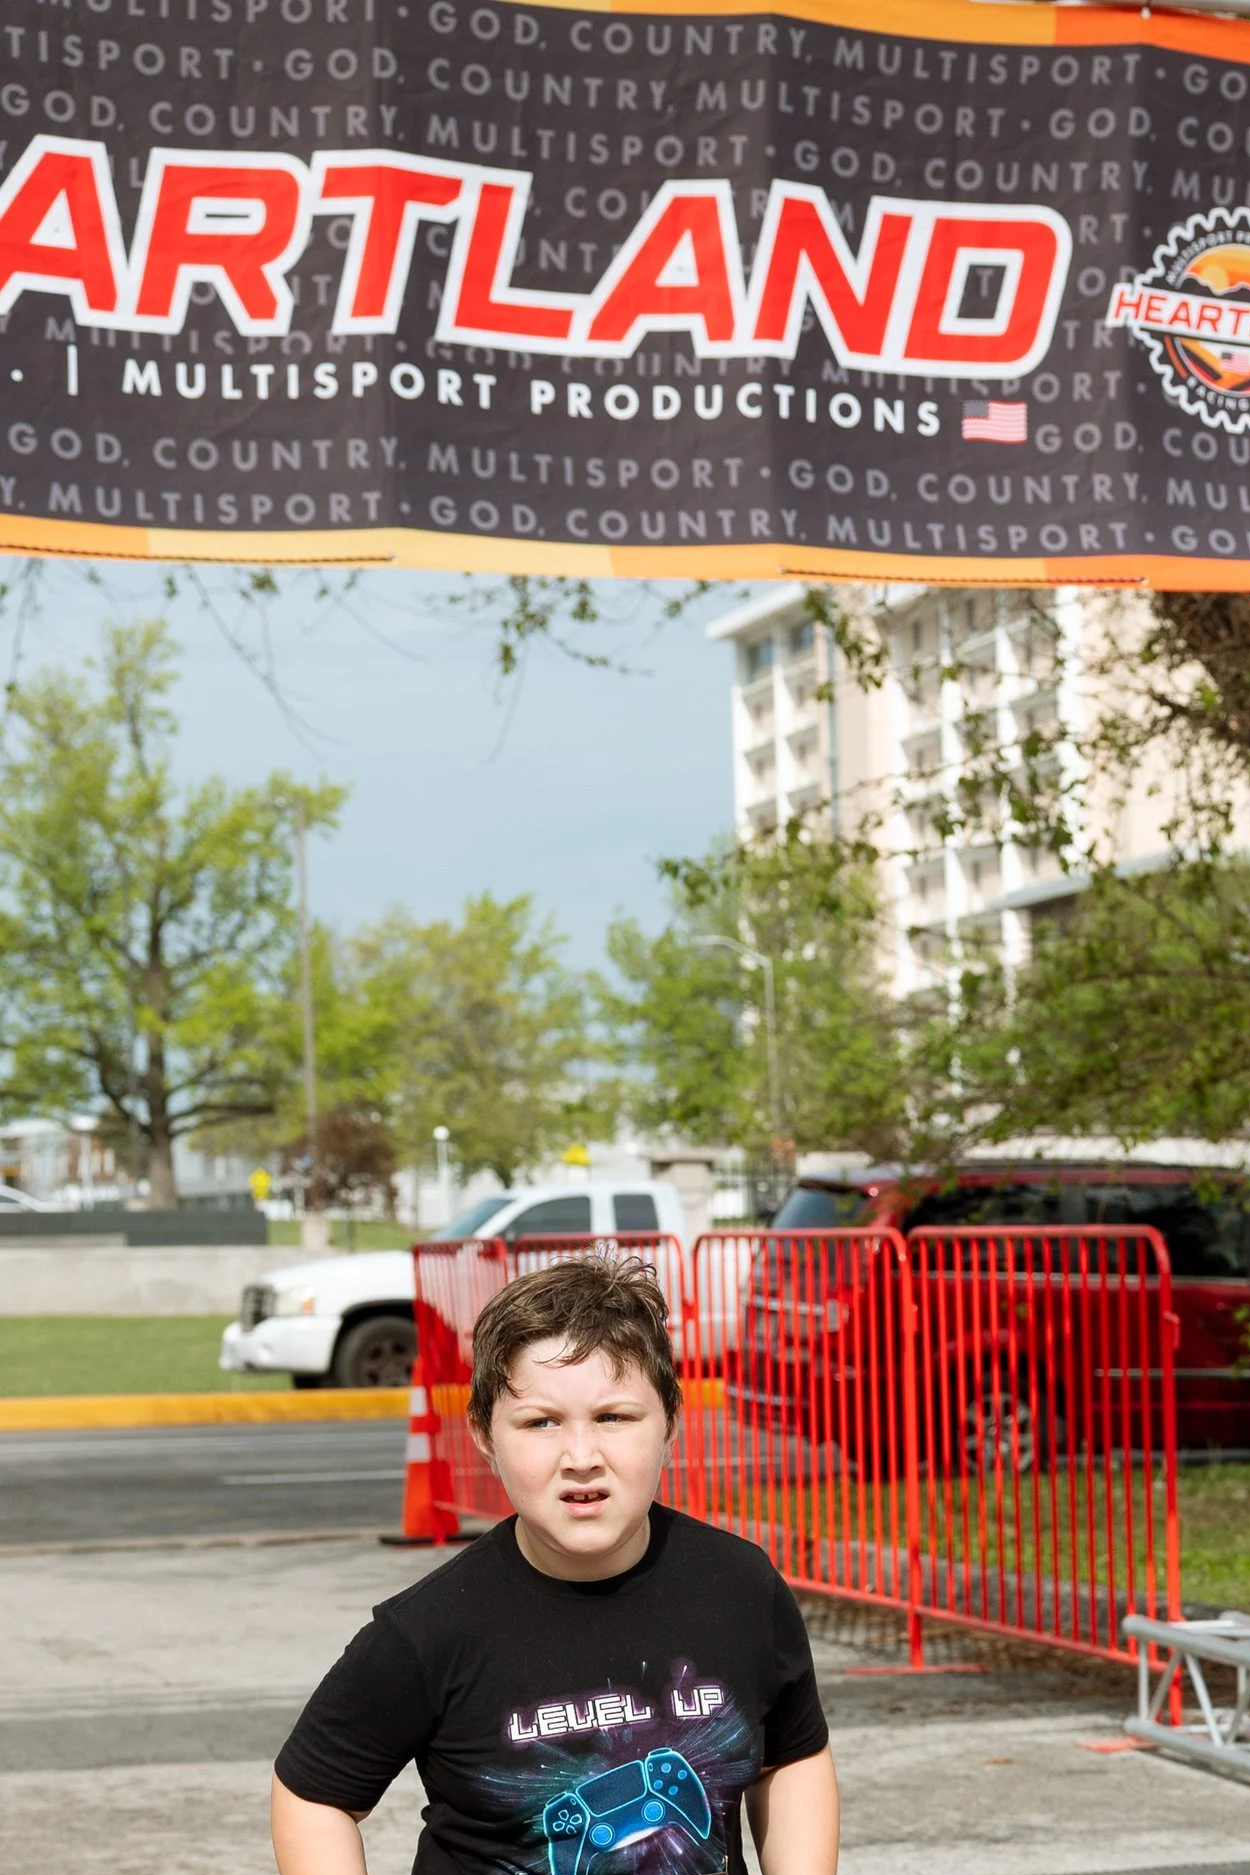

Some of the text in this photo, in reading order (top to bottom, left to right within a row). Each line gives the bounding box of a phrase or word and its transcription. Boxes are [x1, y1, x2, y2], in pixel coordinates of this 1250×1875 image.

[833, 37, 1141, 86] MULTISPORT
[696, 80, 1005, 138] MULTISPORT
[427, 114, 748, 168] MULTISPORT
[0, 134, 1073, 381] ARTLAND
[122, 357, 940, 436] MULTISPORT PRODUCTIONS
[1186, 375, 1250, 411] RACING
[427, 442, 744, 489] MULTISPORT
[49, 481, 382, 524] MULTISPORT
[827, 514, 1128, 551] MULTISPORT
[508, 1685, 724, 1742] LEVEL UP
